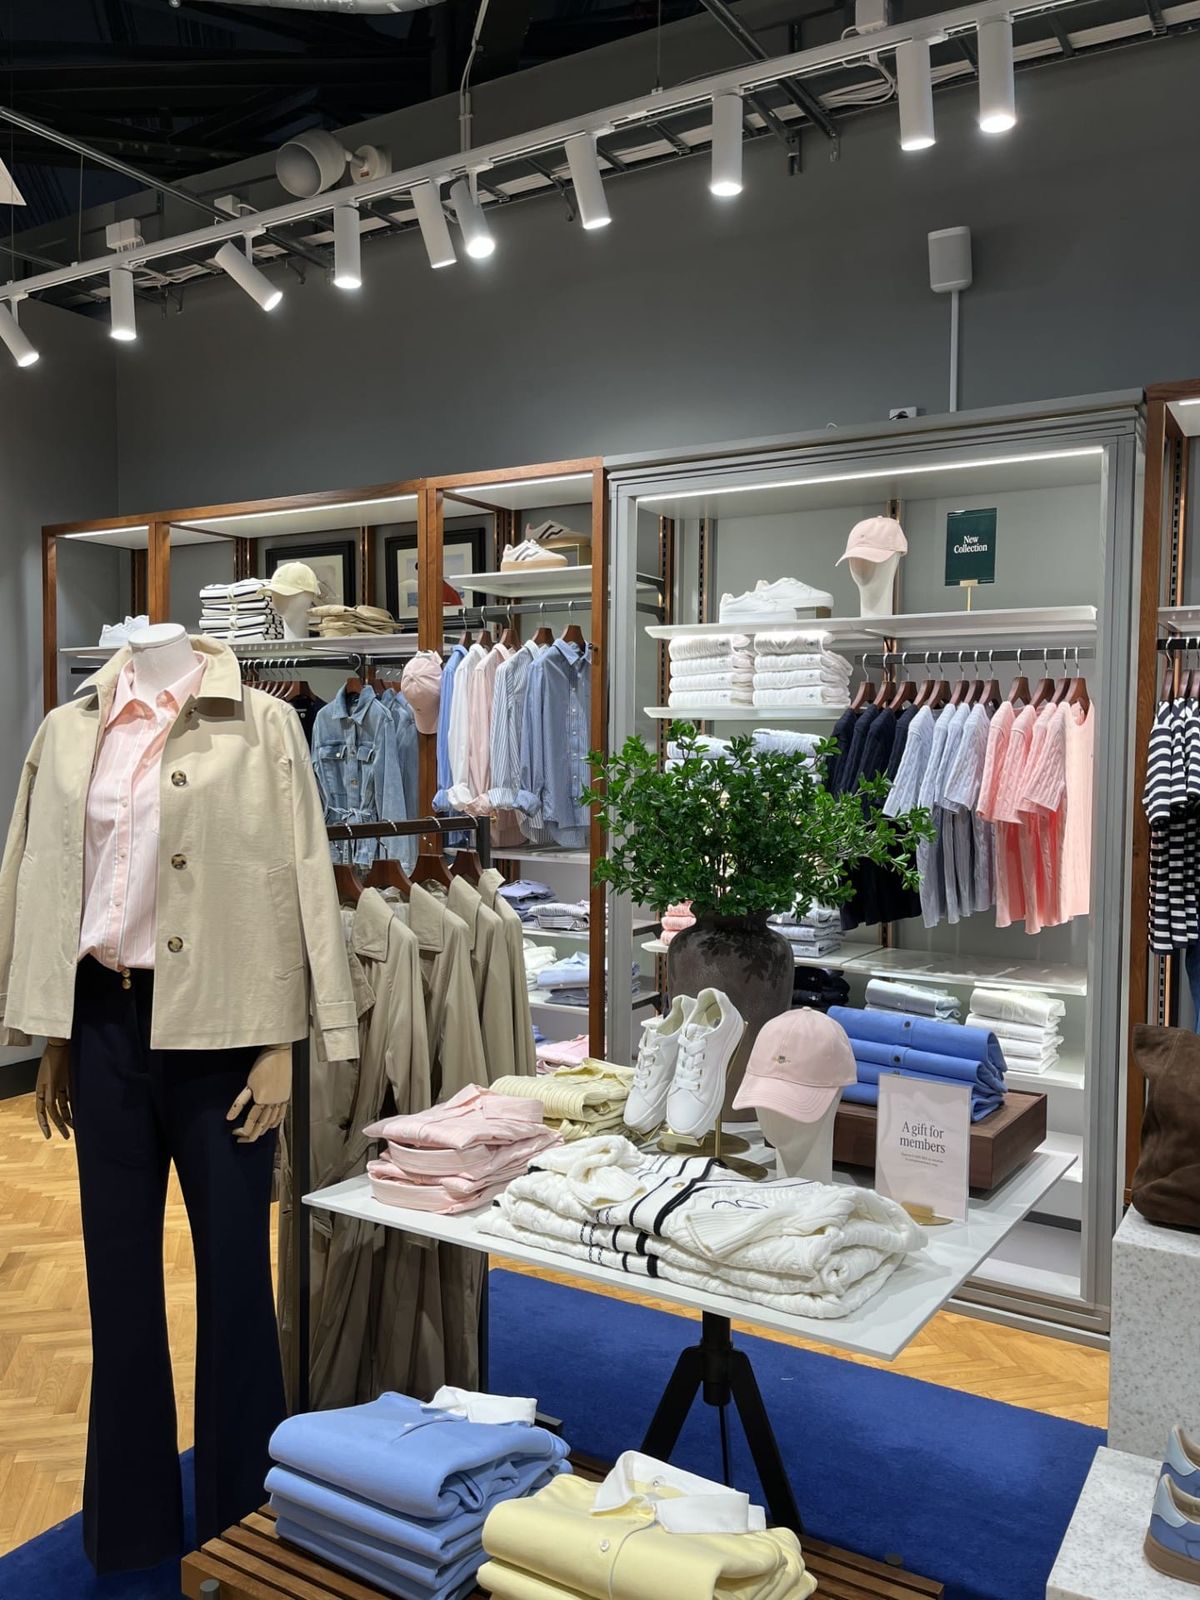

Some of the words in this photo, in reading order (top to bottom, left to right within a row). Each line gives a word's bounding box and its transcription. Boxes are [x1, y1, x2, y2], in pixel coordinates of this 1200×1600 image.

[963, 535, 979, 544] New
[953, 543, 988, 554] Collection
[902, 1121, 910, 1133] A
[911, 1123, 928, 1137] gift
[929, 1124, 945, 1139] for
[899, 1137, 946, 1154] members
